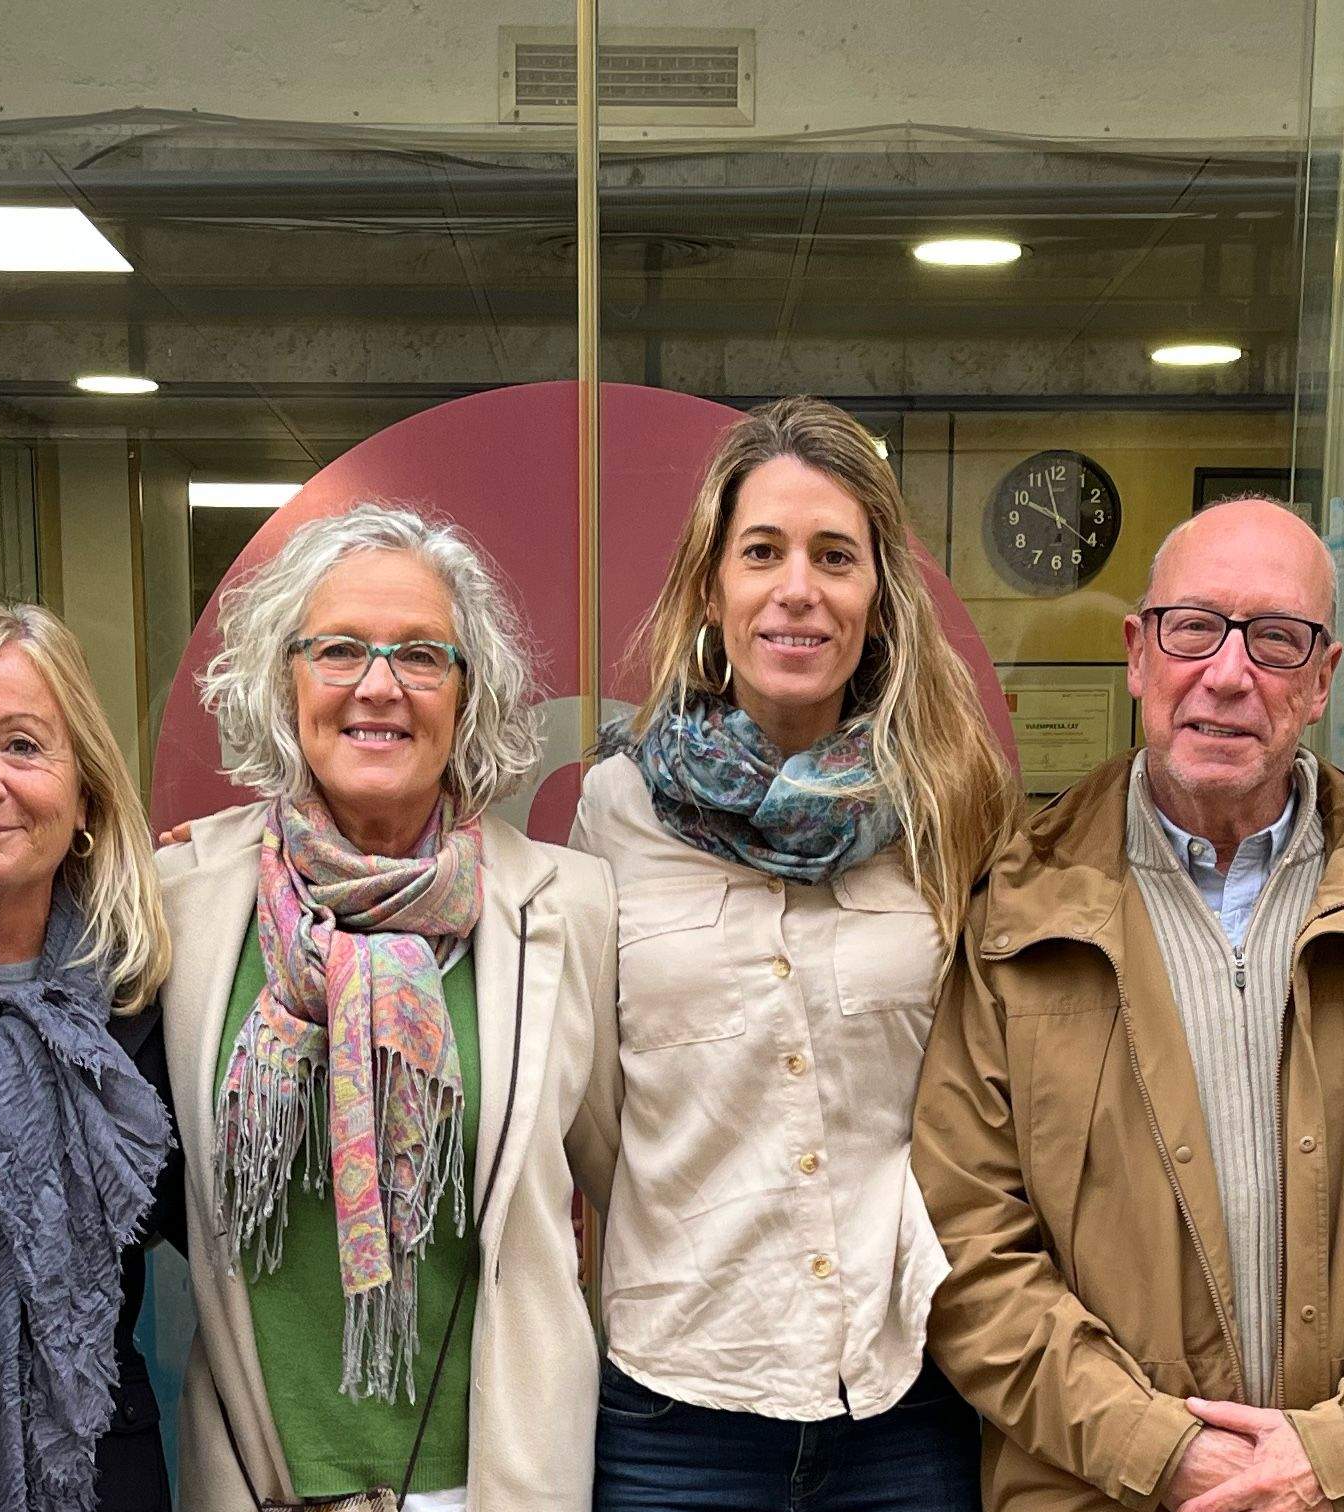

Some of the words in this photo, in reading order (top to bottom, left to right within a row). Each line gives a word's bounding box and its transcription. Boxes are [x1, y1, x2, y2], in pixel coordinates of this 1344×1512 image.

[1028, 472, 1042, 487] 11
[1050, 465, 1066, 481] 12
[1079, 473, 1086, 488] 1
[1013, 490, 1029, 506] 10
[1090, 488, 1101, 503] 2
[1009, 510, 1020, 525] 9
[1093, 509, 1105, 524] 3
[1015, 533, 1026, 548] 8
[1087, 532, 1097, 547] 4
[1032, 550, 1043, 565] 7
[1051, 555, 1062, 570] 6
[1071, 550, 1082, 565] 5
